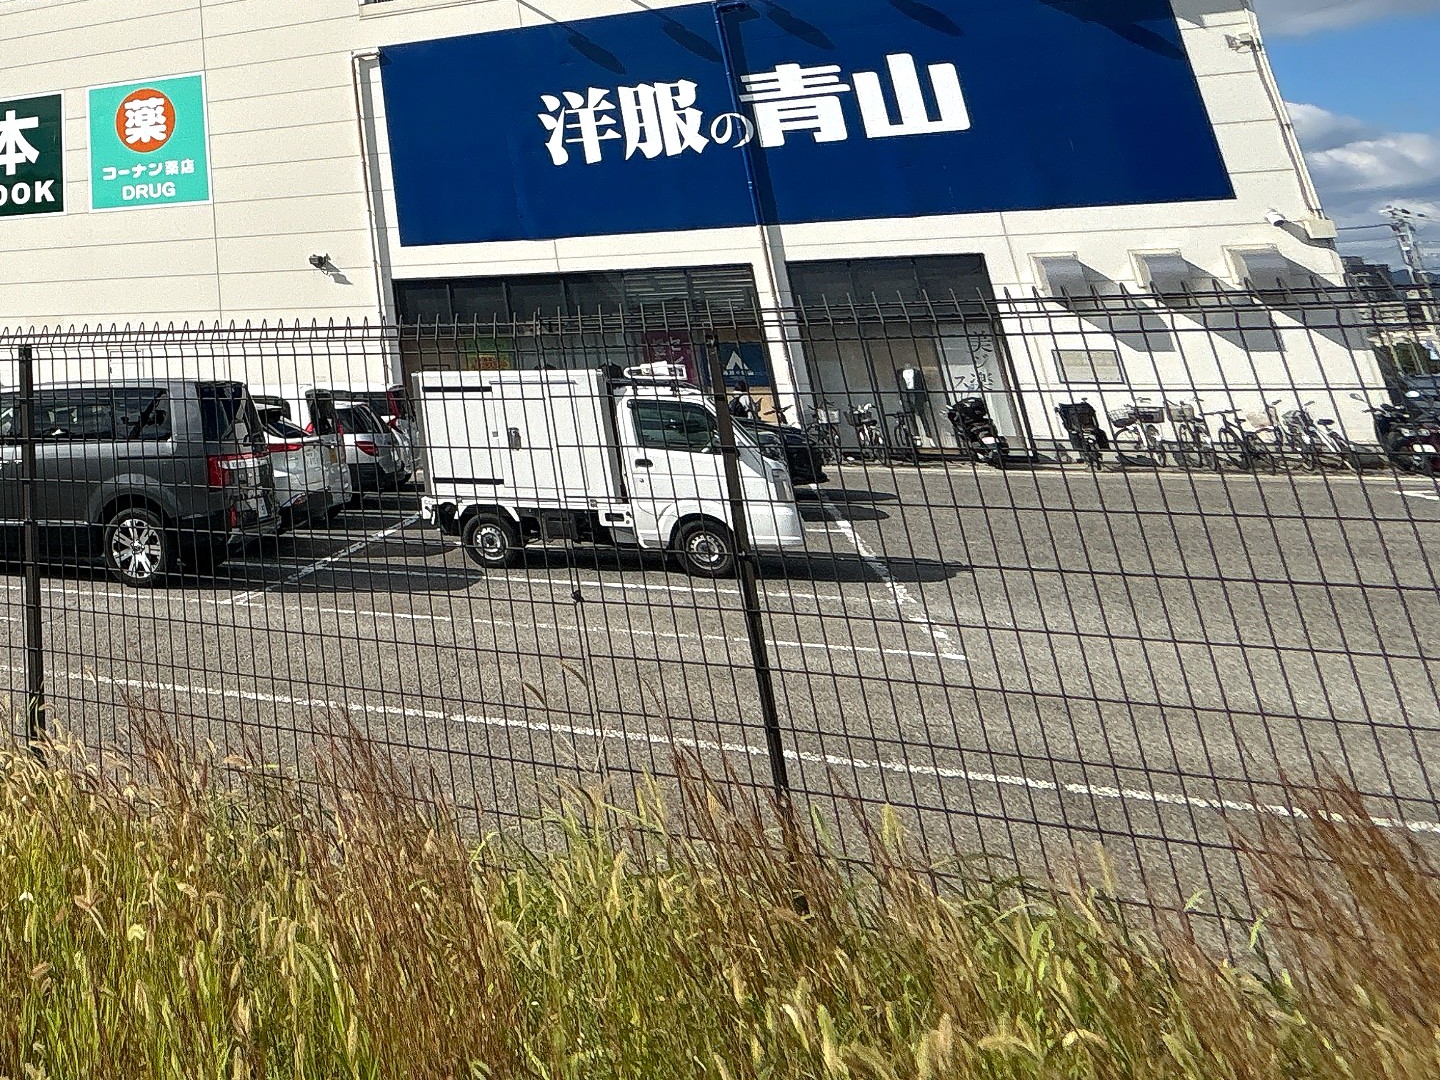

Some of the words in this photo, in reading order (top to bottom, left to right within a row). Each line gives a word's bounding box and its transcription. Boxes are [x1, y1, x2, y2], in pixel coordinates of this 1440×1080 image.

[124, 97, 167, 145] 薬
[537, 52, 972, 167] 洋服の青山
[102, 158, 195, 181] コーナン薬店
[122, 182, 176, 200] DRUG
